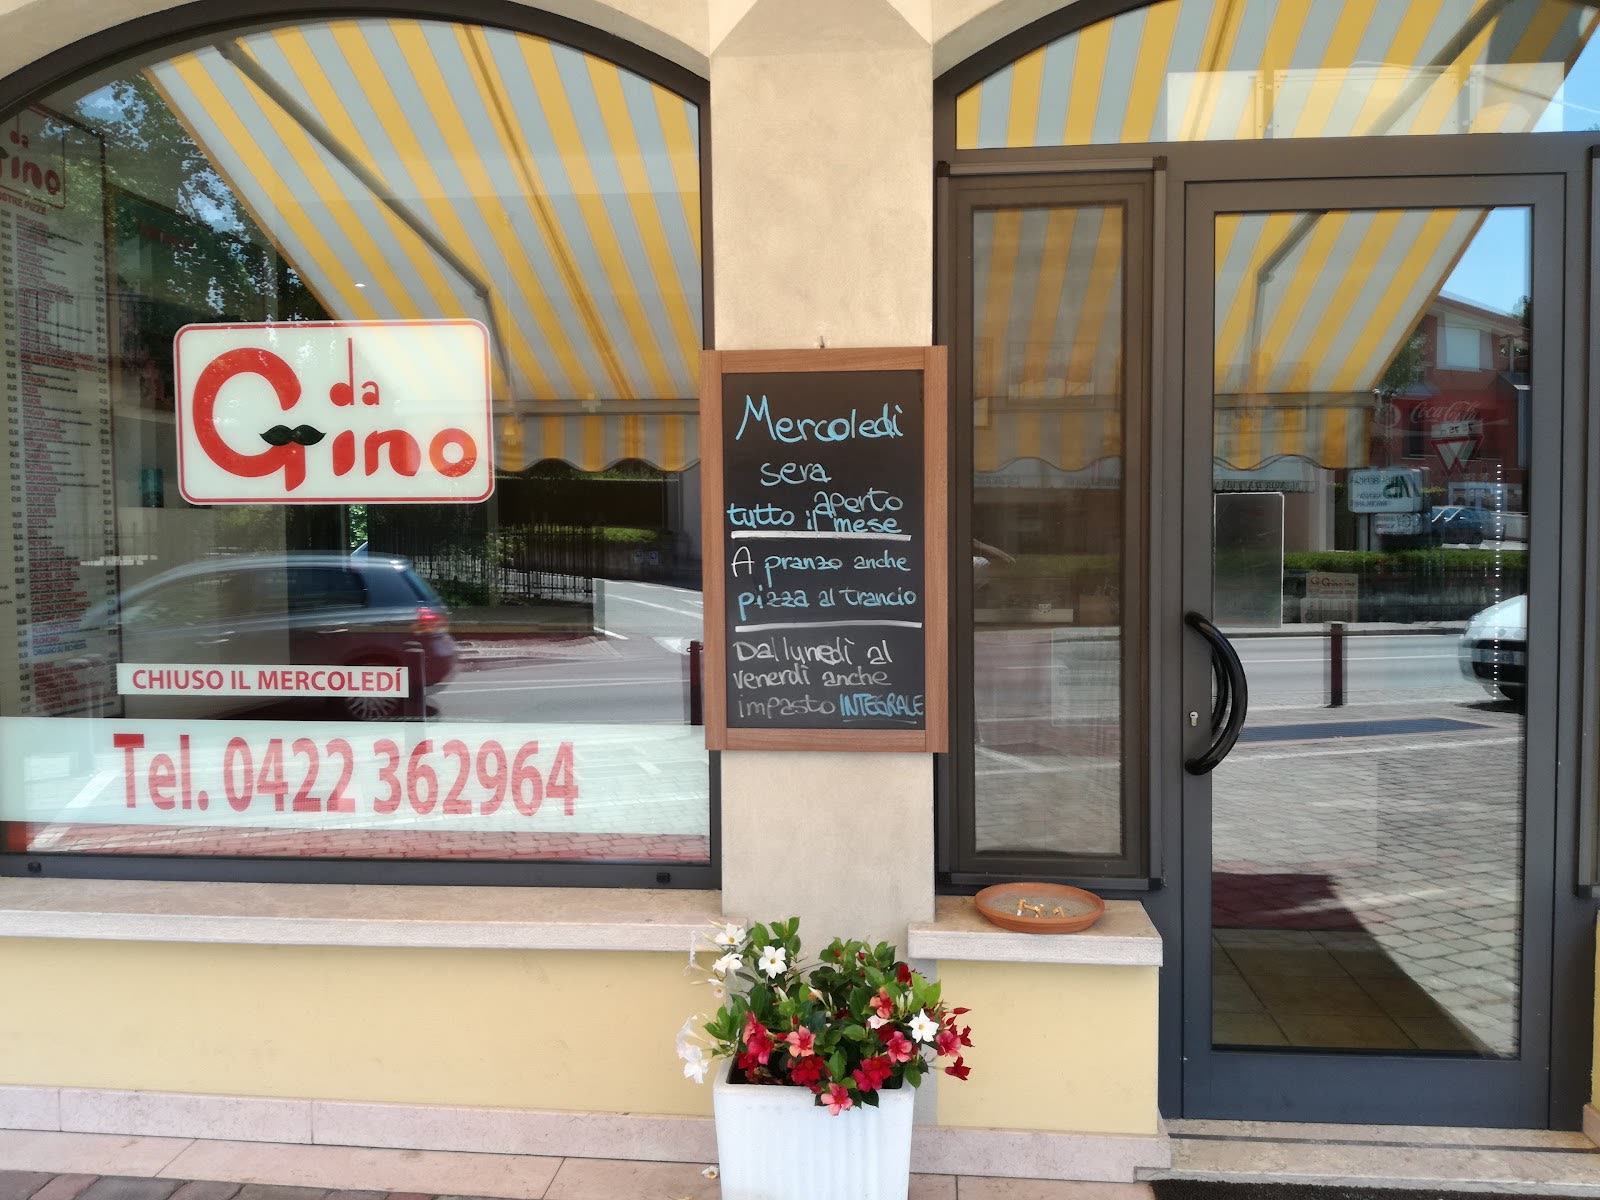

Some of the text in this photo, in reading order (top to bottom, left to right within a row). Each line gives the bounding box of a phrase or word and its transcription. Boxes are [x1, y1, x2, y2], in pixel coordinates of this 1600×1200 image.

[0, 156, 61, 195] ino
[329, 338, 380, 406] da
[192, 346, 478, 492] Gino
[736, 394, 904, 443] Mercoledì
[759, 461, 832, 487] sera
[726, 502, 902, 534] tutto il mese
[813, 488, 904, 518] aperto
[731, 545, 911, 588] A pranzo anche
[737, 585, 917, 622] pizza al trancio
[732, 636, 893, 666] Dal lunedì al
[131, 669, 225, 692] CHIUSO
[231, 671, 253, 693] IL
[732, 663, 892, 690] venerdì anche
[737, 693, 924, 719] impasto INTEGRALE
[113, 733, 579, 817] Tel. 0422 362964
